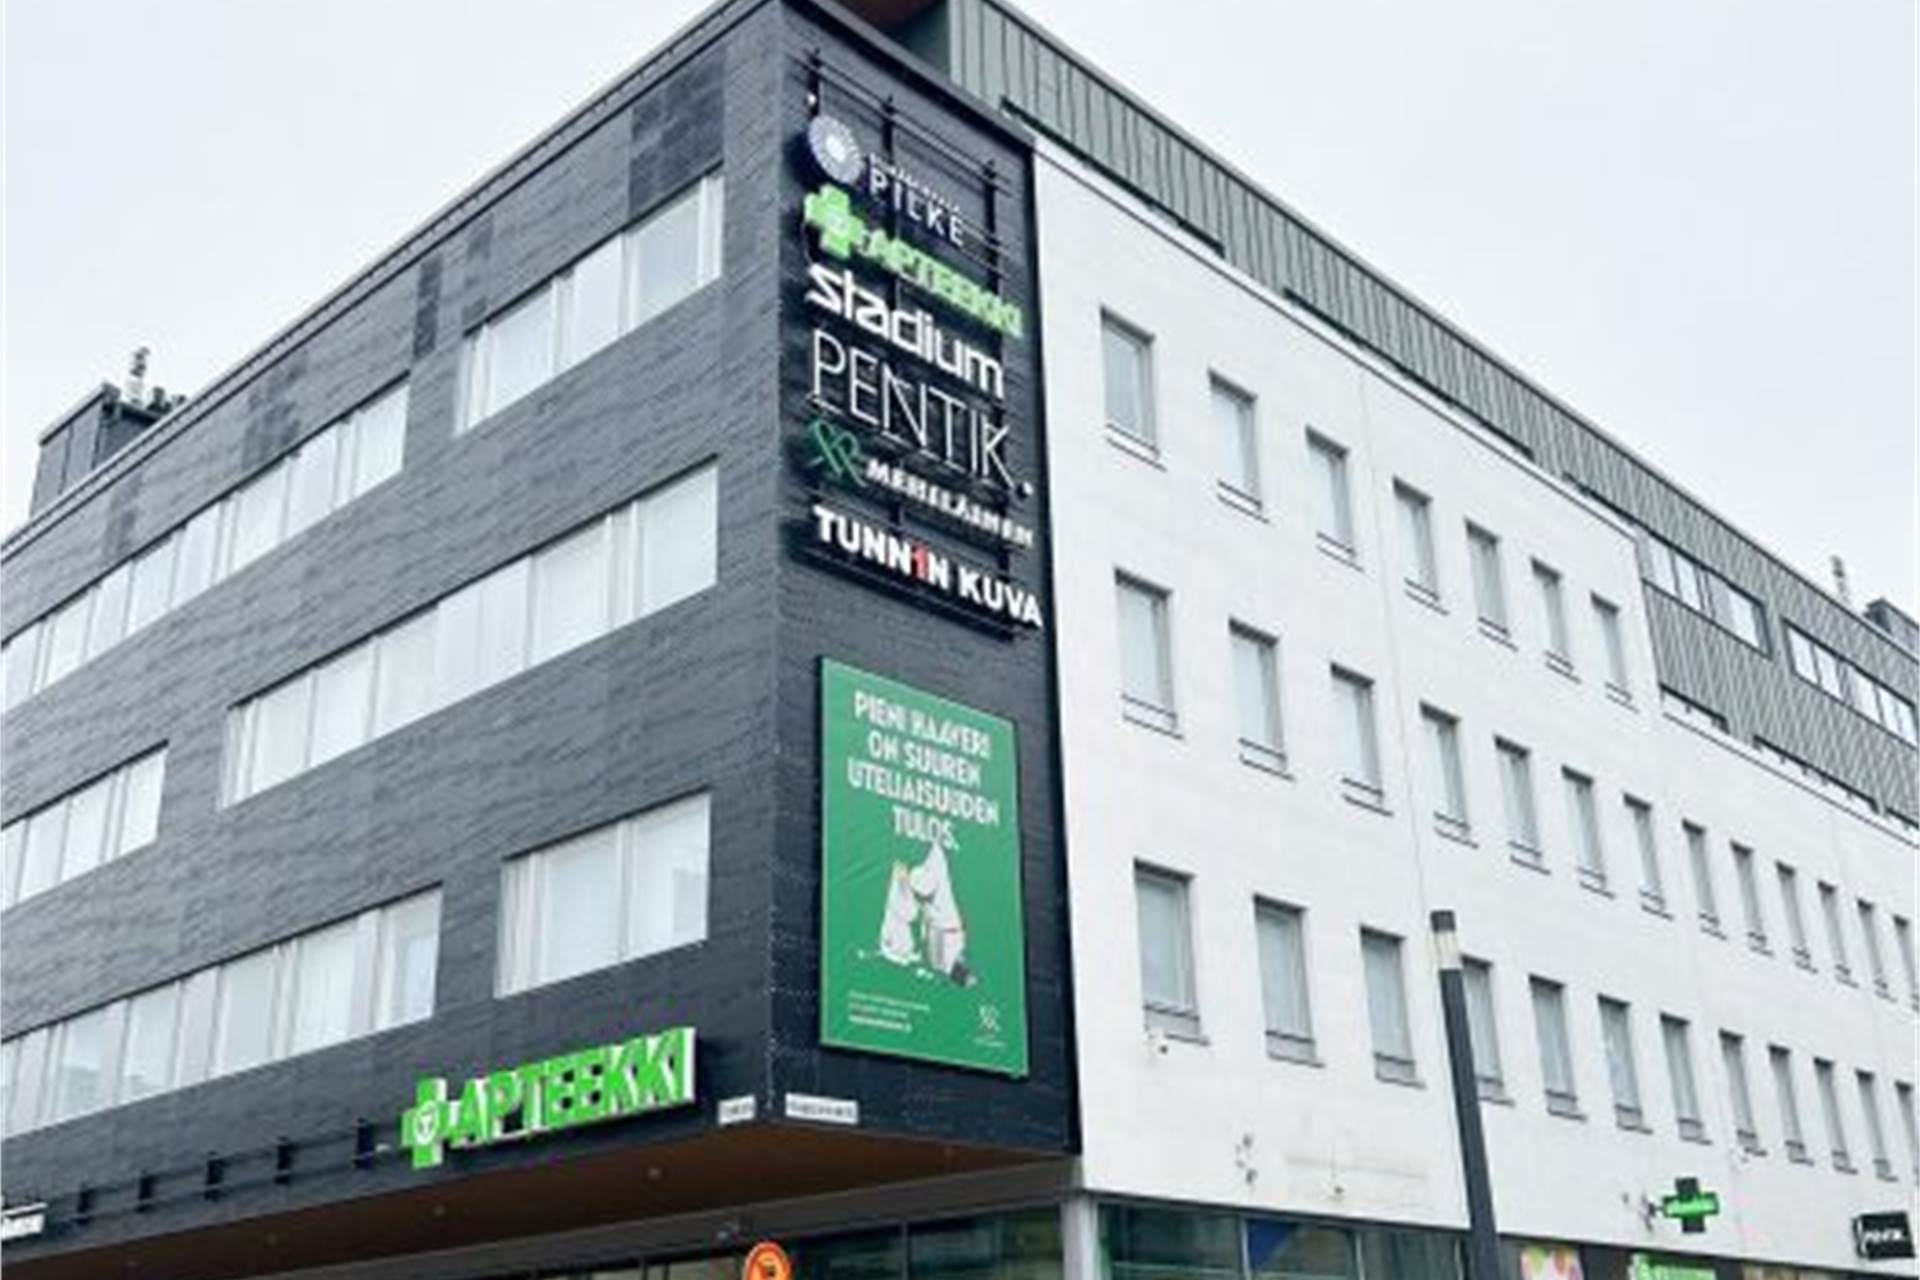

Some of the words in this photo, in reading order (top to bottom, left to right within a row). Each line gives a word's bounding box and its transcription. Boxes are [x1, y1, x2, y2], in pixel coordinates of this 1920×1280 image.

[869, 166, 963, 247] PILKE
[860, 228, 1024, 339] APTEEKKI
[806, 263, 1005, 399] stadium
[958, 565, 1043, 628] KUVA
[854, 690, 905, 733] PIENI
[867, 730, 899, 761] ON
[902, 741, 982, 787] SUUREN
[450, 1026, 697, 1149] APTEEKKI
